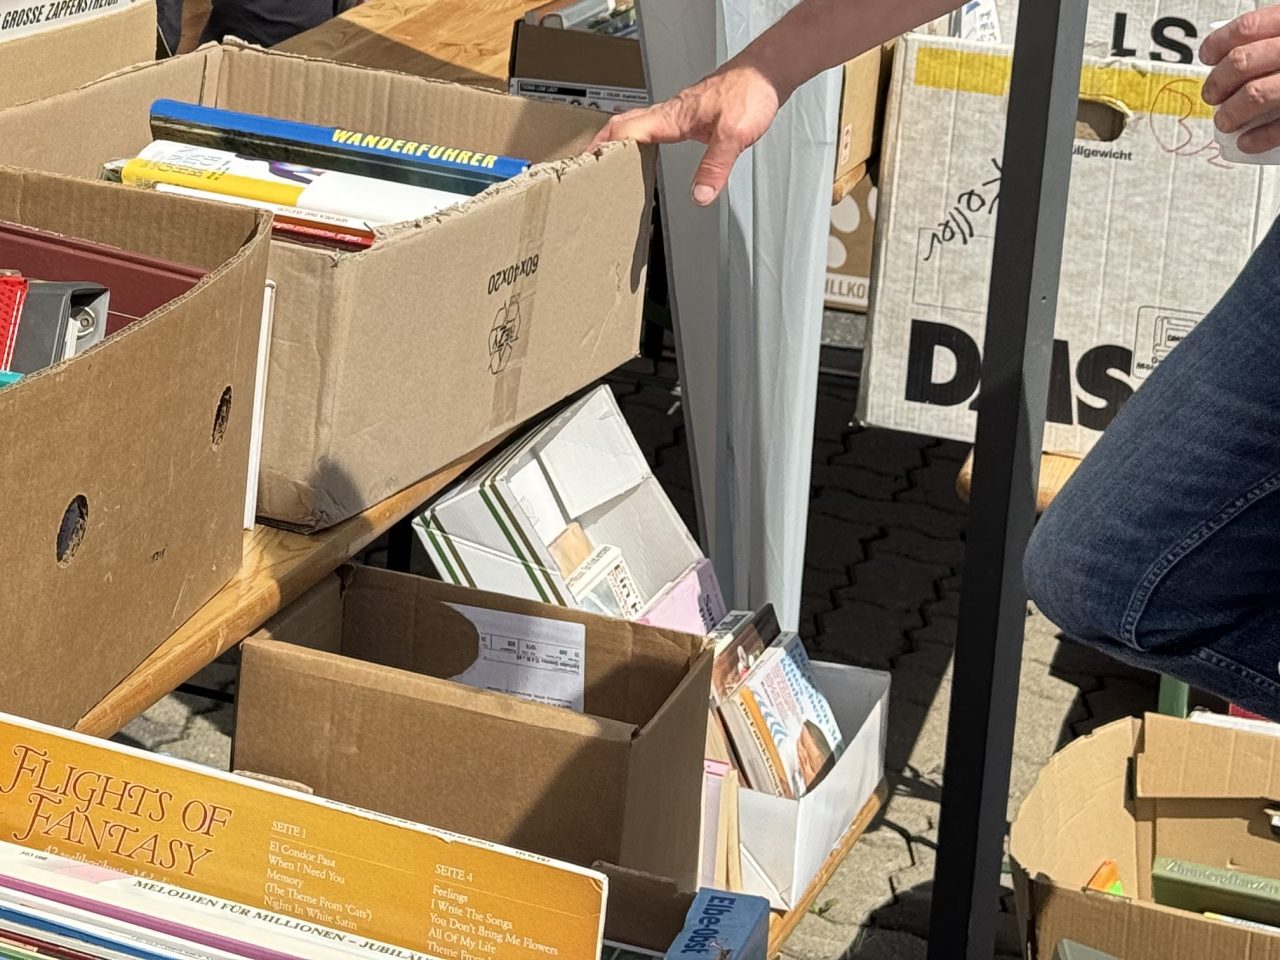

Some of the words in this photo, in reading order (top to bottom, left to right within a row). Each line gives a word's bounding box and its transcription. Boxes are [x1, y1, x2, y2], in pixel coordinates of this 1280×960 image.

[2, 4, 46, 31] GROSSE
[488, 253, 540, 295] 60x40x20
[825, 278, 866, 299] ILLKO
[181, 798, 233, 838] OF
[271, 821, 300, 837] SEITE
[13, 791, 213, 879] FANTASY
[268, 854, 294, 873] When
[301, 864, 327, 880] Need
[327, 871, 346, 885] You
[269, 841, 279, 854] El
[280, 844, 316, 863] Condor
[316, 852, 336, 868] Pasa
[266, 868, 304, 889] Memory
[435, 864, 465, 881] SEITE
[466, 872, 473, 883] 4
[264, 881, 287, 898] (The
[288, 886, 319, 906] Theme
[319, 896, 343, 913] From
[433, 885, 469, 905] Feelings
[133, 880, 219, 908] MELODIEN
[220, 900, 251, 918] FÜR
[252, 910, 346, 944] MILLIONEN
[264, 896, 294, 916] Nights
[295, 904, 305, 915] In
[305, 906, 333, 923] White
[334, 915, 358, 931] Satin
[437, 901, 463, 917] Write
[464, 907, 484, 922] The
[485, 913, 513, 931] Songs
[679, 894, 737, 955] Elbe-Obst
[427, 927, 442, 939] All
[444, 930, 459, 942] Of
[460, 935, 475, 949] My
[476, 939, 497, 954] Life
[430, 913, 447, 928] You
[477, 925, 504, 944] Bring
[505, 933, 521, 946] Me
[522, 936, 559, 956] Flowers
[426, 941, 458, 959] Theme
